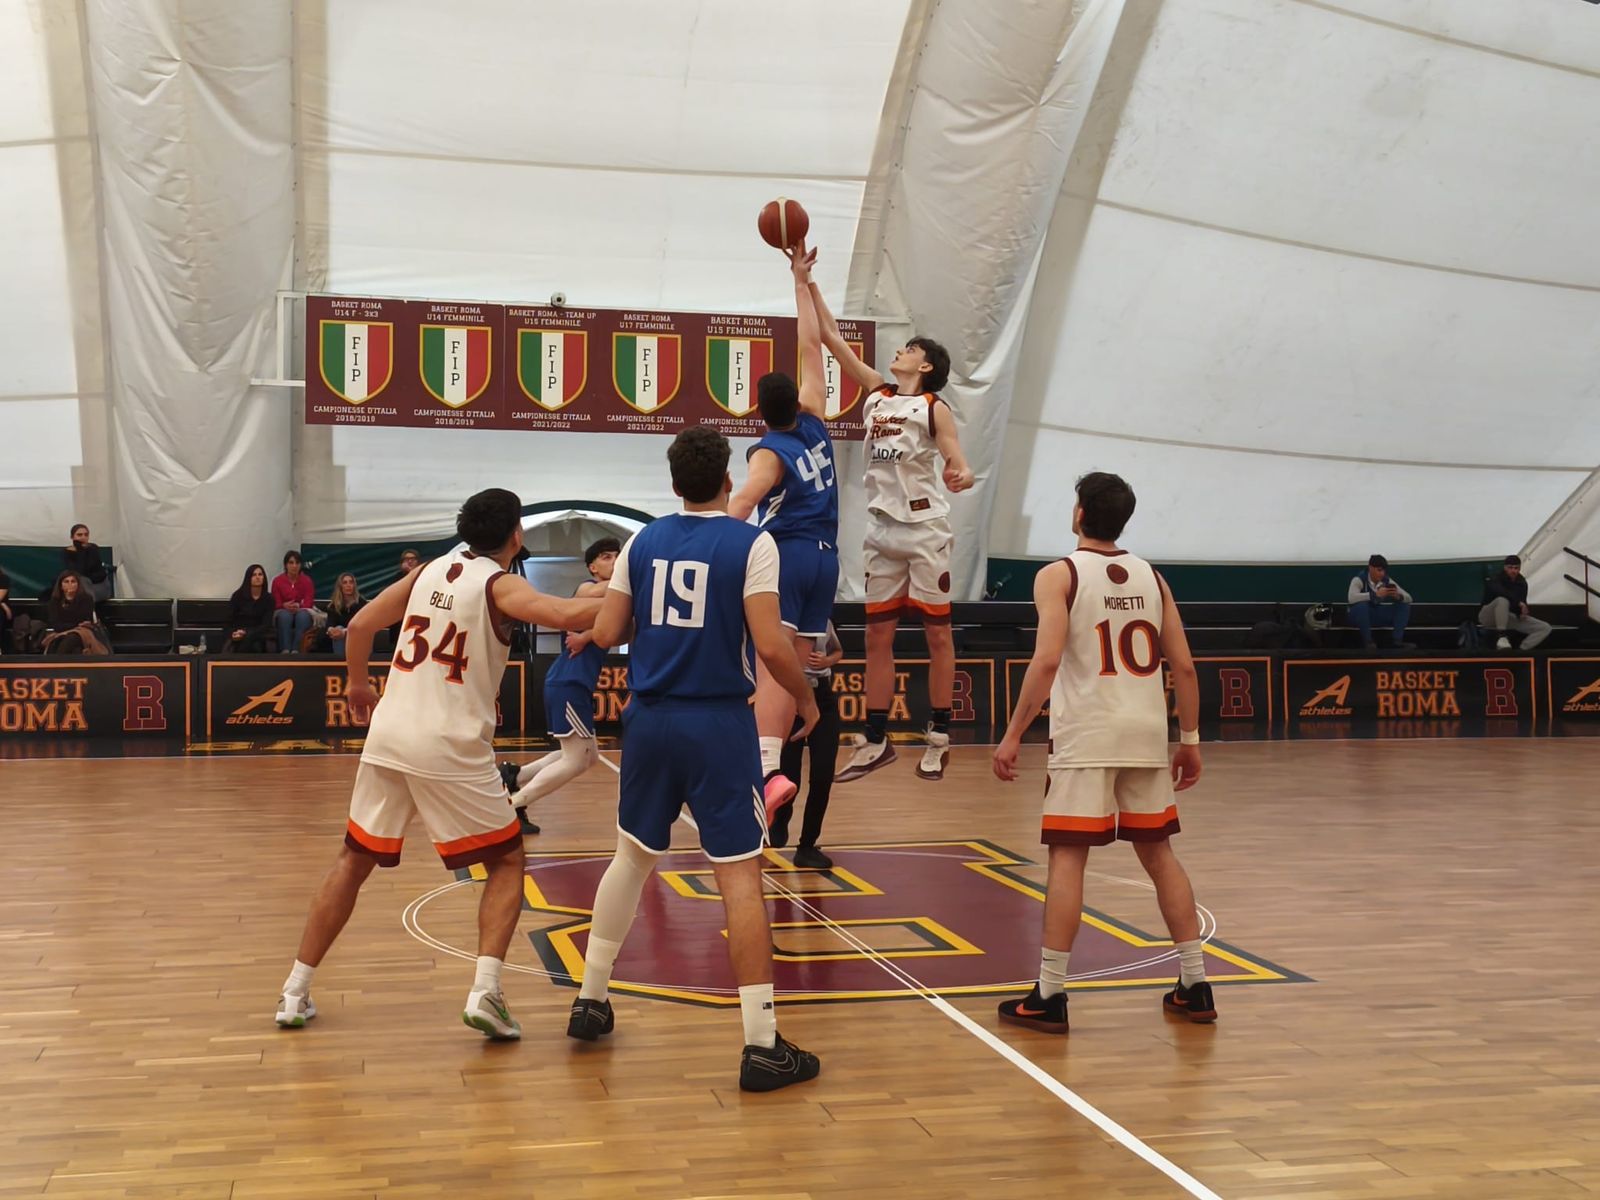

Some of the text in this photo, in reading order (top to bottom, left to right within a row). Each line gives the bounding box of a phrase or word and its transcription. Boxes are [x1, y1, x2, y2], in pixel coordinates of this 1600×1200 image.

[431, 305, 458, 313] BASKET
[710, 316, 740, 325] BASKET
[726, 326, 772, 336] FEMMINILE
[313, 406, 366, 414] CAMPIONESSE
[413, 409, 464, 417] CAMPIONESSE
[512, 412, 561, 420] CAMPIONESSE
[796, 440, 834, 491] 45
[651, 558, 710, 628] 19
[1104, 596, 1144, 610] MORETTI
[392, 614, 469, 685] 34
[1094, 619, 1161, 678] 10
[1376, 671, 1459, 689] BASKET
[0, 677, 88, 699] ASKET
[1377, 691, 1461, 717] ROMA
[1563, 703, 1600, 712] athlet
[0, 701, 88, 731] OMA
[1300, 707, 1352, 716] athletes
[226, 715, 294, 725] athletes
